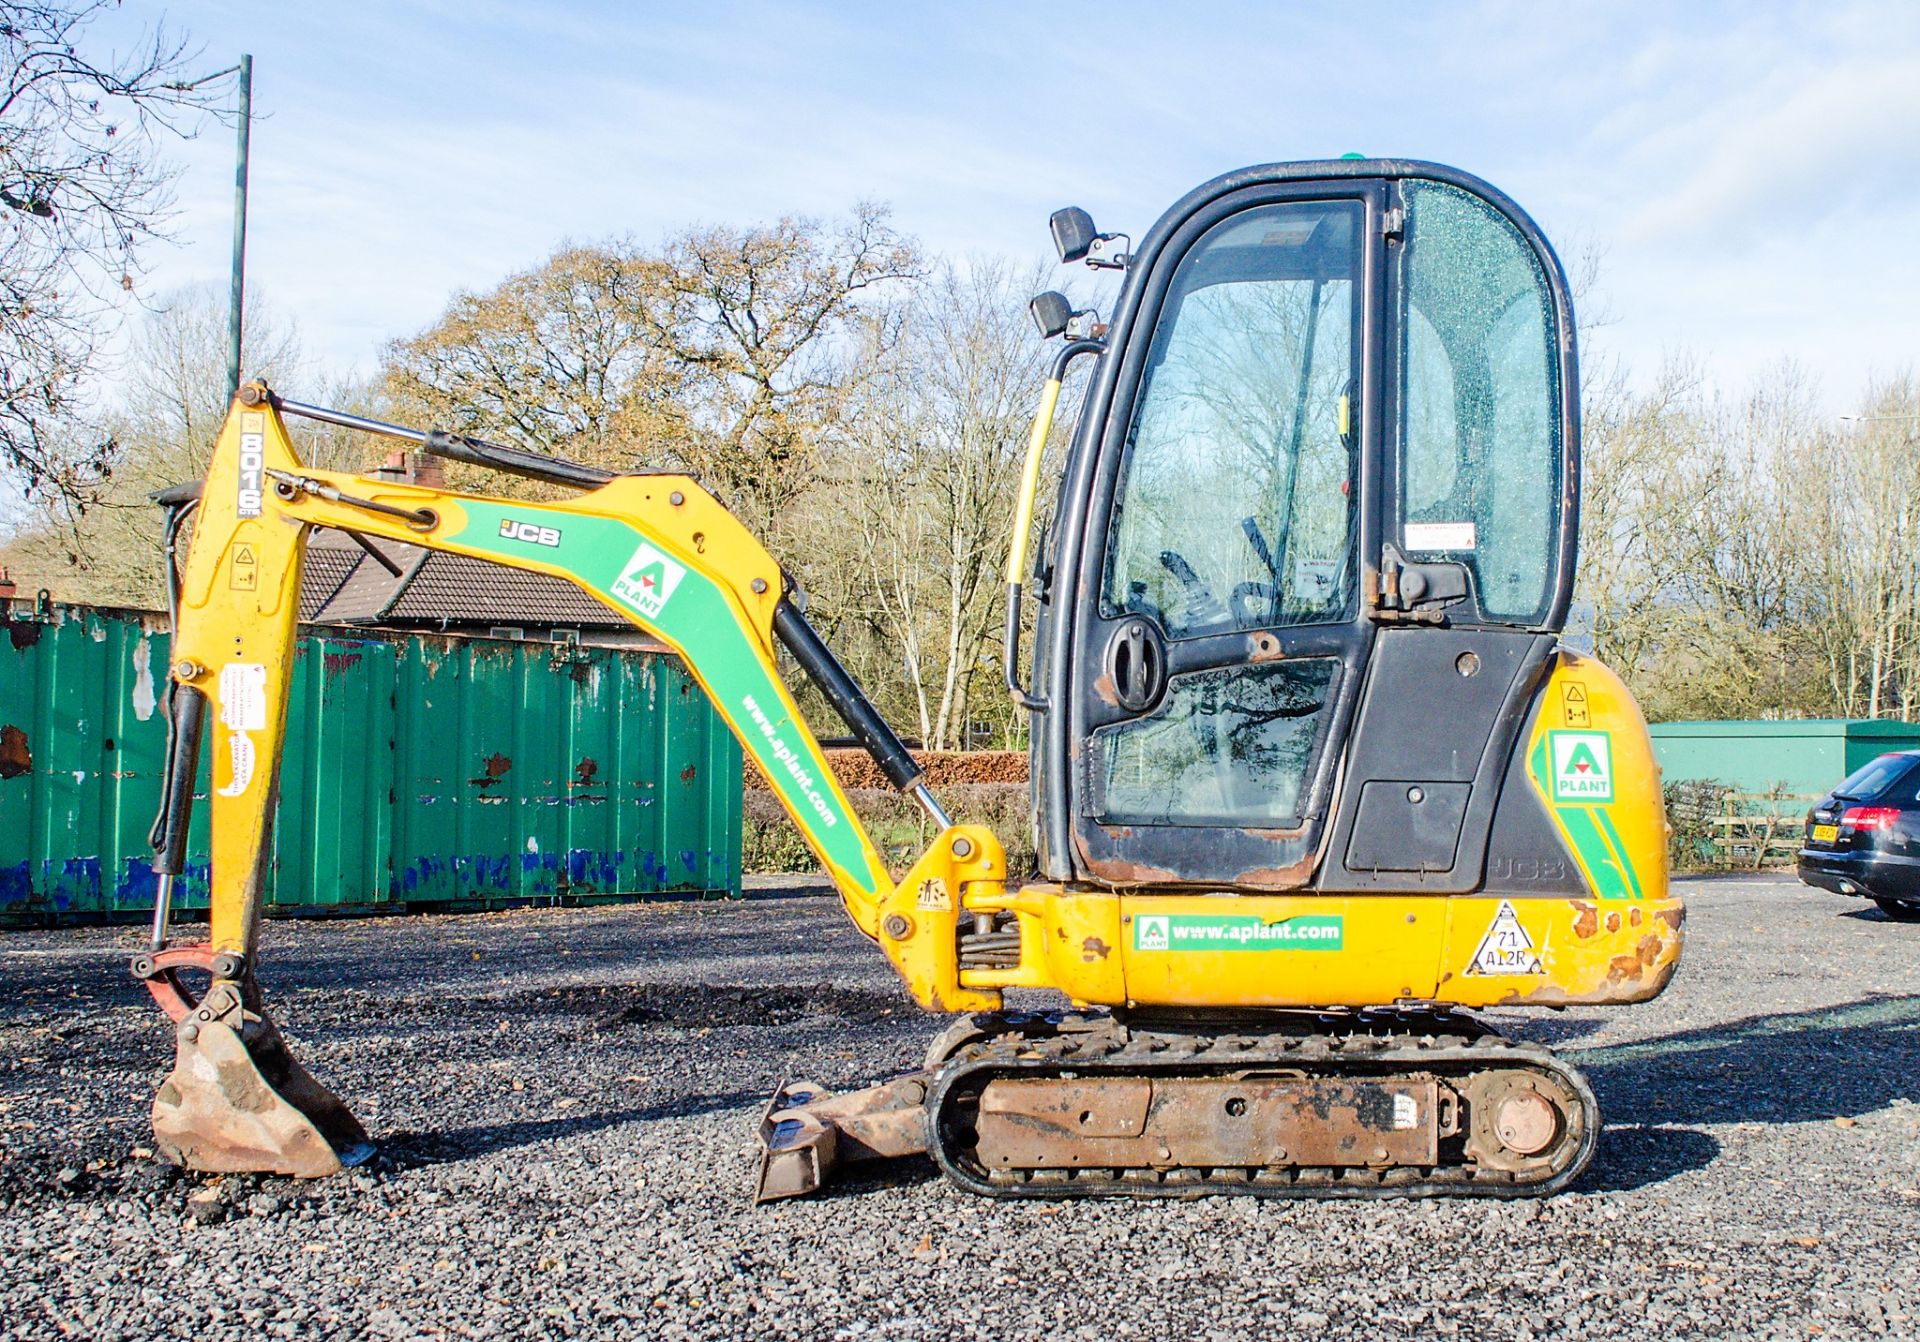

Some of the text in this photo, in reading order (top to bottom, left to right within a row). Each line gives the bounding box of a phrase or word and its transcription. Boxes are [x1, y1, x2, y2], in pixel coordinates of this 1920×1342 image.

[239, 434, 263, 509] 8016
[499, 520, 561, 547] JCB
[615, 580, 660, 613] PLANT
[742, 694, 837, 828] www.aplant.com
[1564, 742, 1604, 775] A
[1559, 780, 1607, 793] PLANT
[1140, 940, 1168, 948] PLANT
[1172, 922, 1340, 943] www.aplant.com
[1498, 931, 1518, 947] 71
